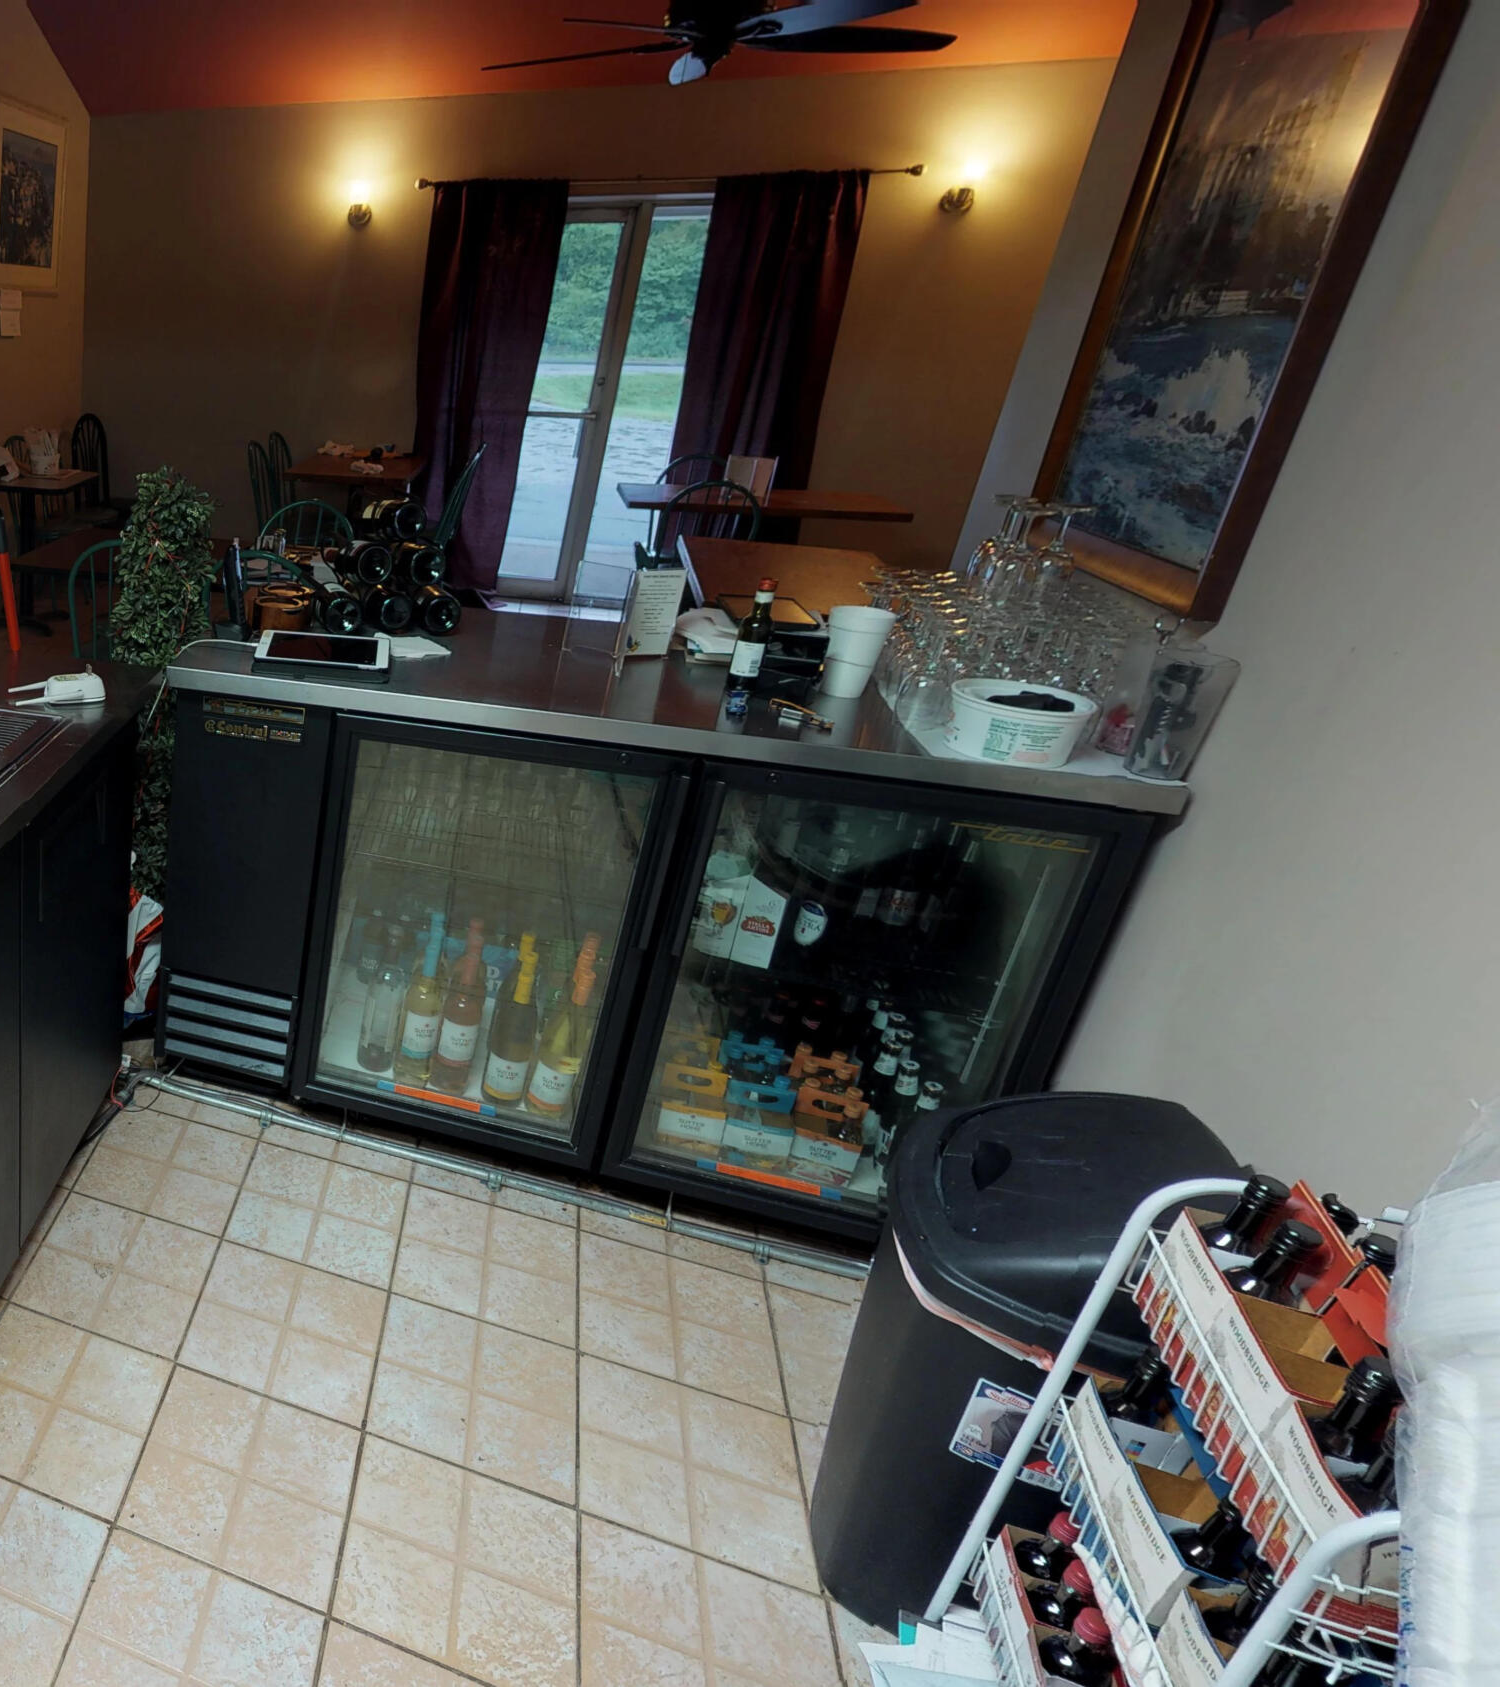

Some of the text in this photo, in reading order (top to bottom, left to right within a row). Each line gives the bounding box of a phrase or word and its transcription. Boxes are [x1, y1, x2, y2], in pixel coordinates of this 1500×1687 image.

[1228, 1316, 1272, 1393] WOODBRIDGE
[1288, 1424, 1338, 1519] WOODBRIDGE
[1126, 1484, 1168, 1564] WOODBRIDGE
[1180, 1612, 1218, 1681] WOODBRID
